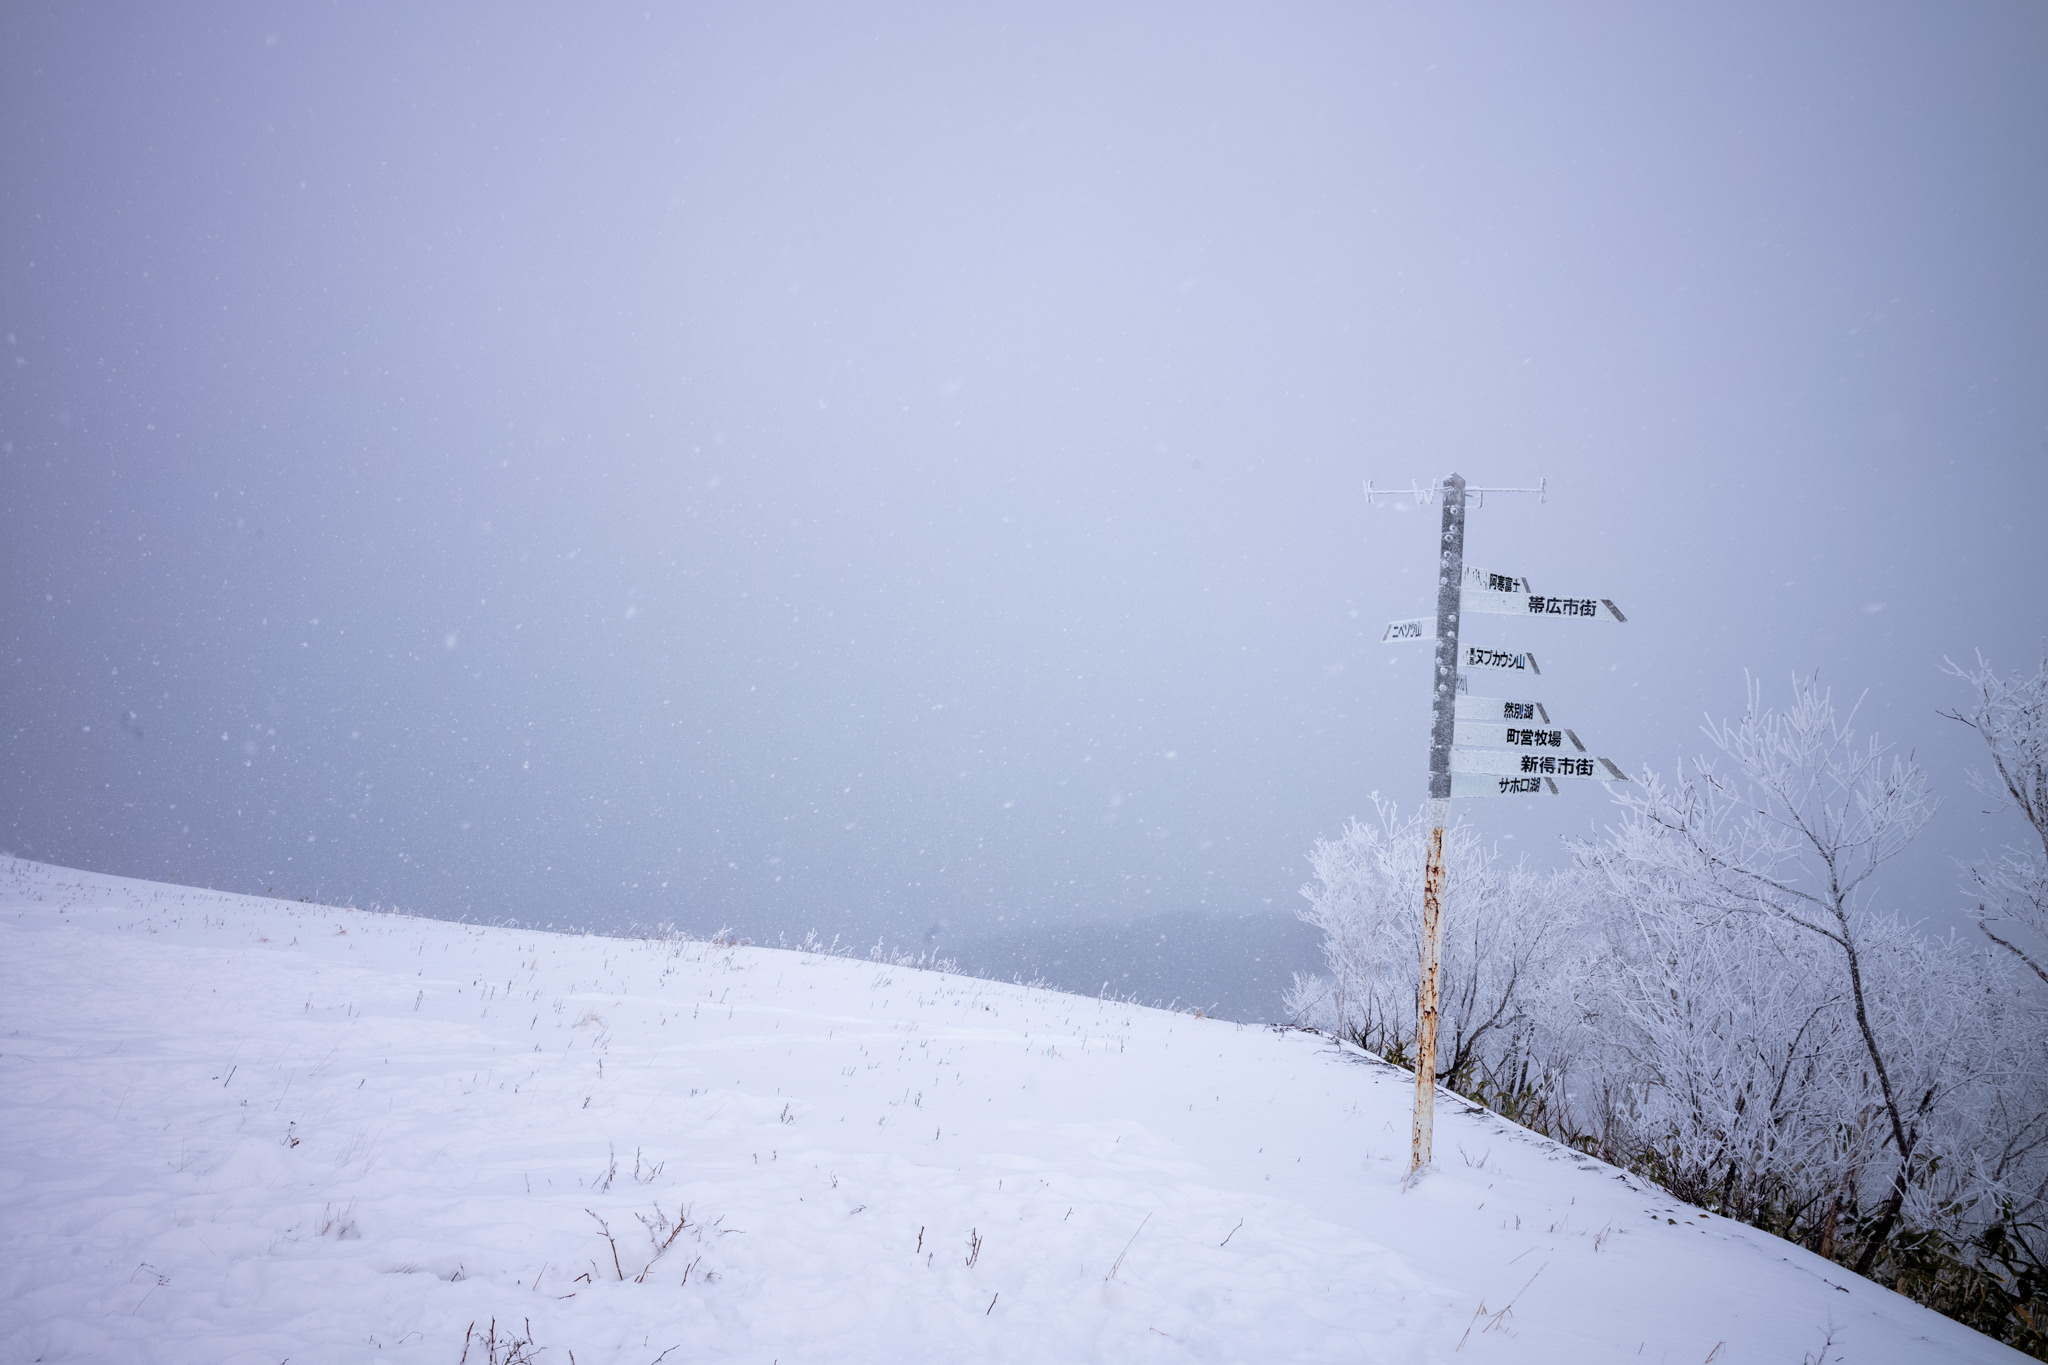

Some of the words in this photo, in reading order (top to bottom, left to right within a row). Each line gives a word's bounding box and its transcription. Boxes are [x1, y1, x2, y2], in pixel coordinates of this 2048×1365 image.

[1489, 573, 1520, 592] 阿寒富士
[1528, 595, 1597, 617] 帯広市街
[1503, 702, 1534, 720] 然別湖
[1506, 728, 1562, 747] 町営牧場
[1520, 755, 1594, 776] 新得市街
[1499, 777, 1541, 794] サホロ湖
